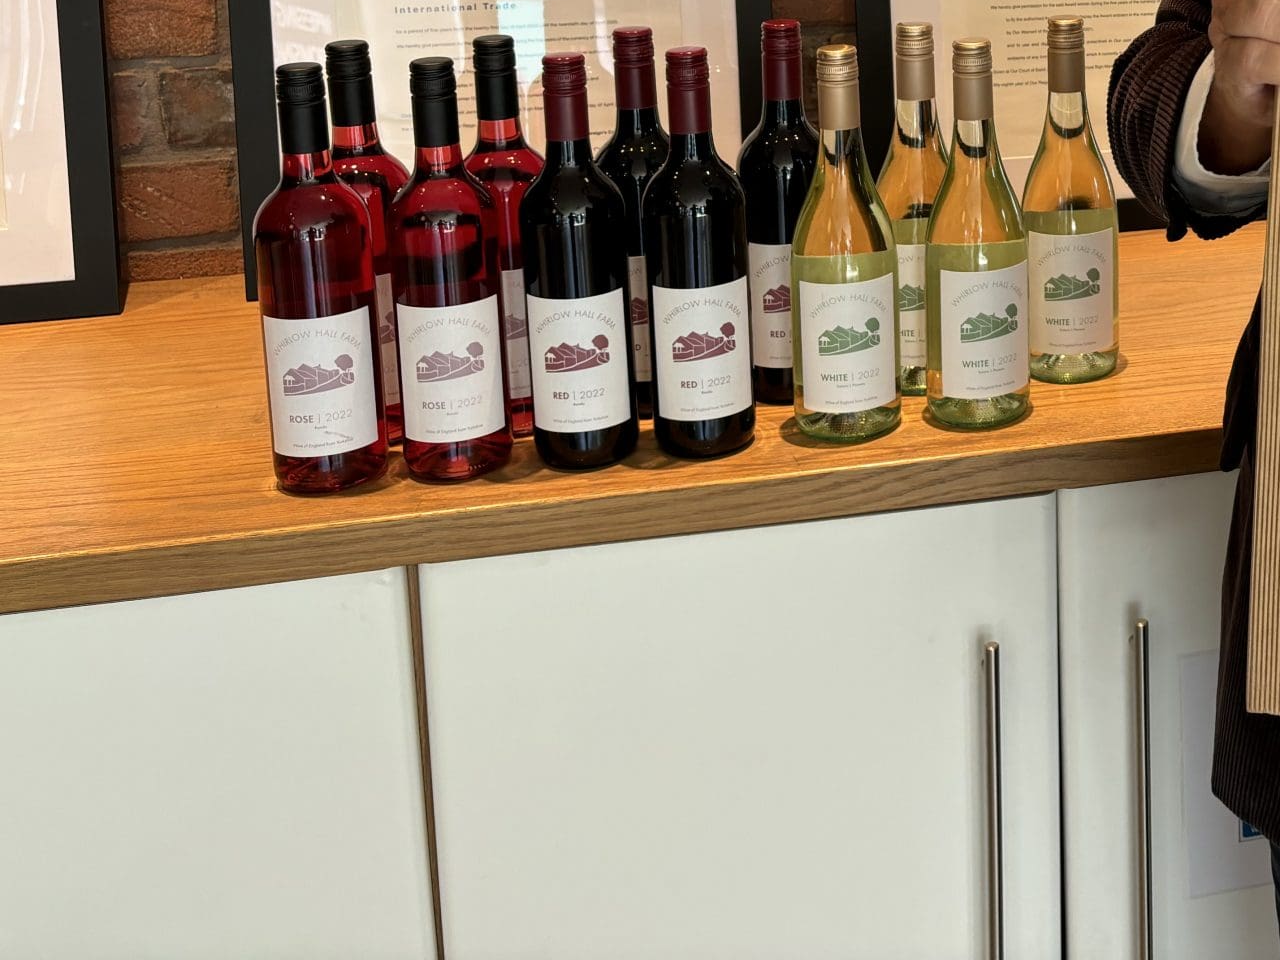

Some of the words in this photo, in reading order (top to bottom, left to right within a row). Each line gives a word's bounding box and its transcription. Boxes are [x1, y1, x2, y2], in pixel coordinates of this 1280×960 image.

[394, 3, 477, 14] International
[483, 2, 516, 11] Trade
[951, 281, 990, 307] WHIRLOW
[992, 280, 1008, 289] HALL
[663, 299, 701, 325] WHIRLOW
[704, 298, 723, 308] HALL
[725, 301, 742, 319] FARM
[810, 295, 847, 319] WHIRLOW
[850, 293, 869, 303] HALL
[870, 297, 887, 313] FARM
[536, 310, 571, 334] WHIRLOW
[574, 310, 594, 319] HALL
[597, 312, 617, 330] FARM
[1045, 317, 1070, 326] WHITE
[407, 318, 444, 343] WHIRLOW
[448, 317, 469, 326] HALL
[770, 330, 786, 338] RED
[274, 330, 311, 356] WHIRLOW
[315, 329, 338, 338] HALL
[341, 332, 361, 349] FARM
[961, 359, 990, 369] WHITE
[998, 353, 1017, 367] 2022
[680, 380, 698, 389] RED
[707, 375, 732, 388] 2022
[820, 373, 848, 382] WHITE
[858, 368, 880, 380] 2022
[553, 391, 569, 400] RED
[580, 388, 606, 400] 2022
[422, 401, 446, 410] ROSE
[457, 395, 482, 408] 2022
[289, 415, 314, 424] ROSE
[326, 408, 353, 422] 2022
